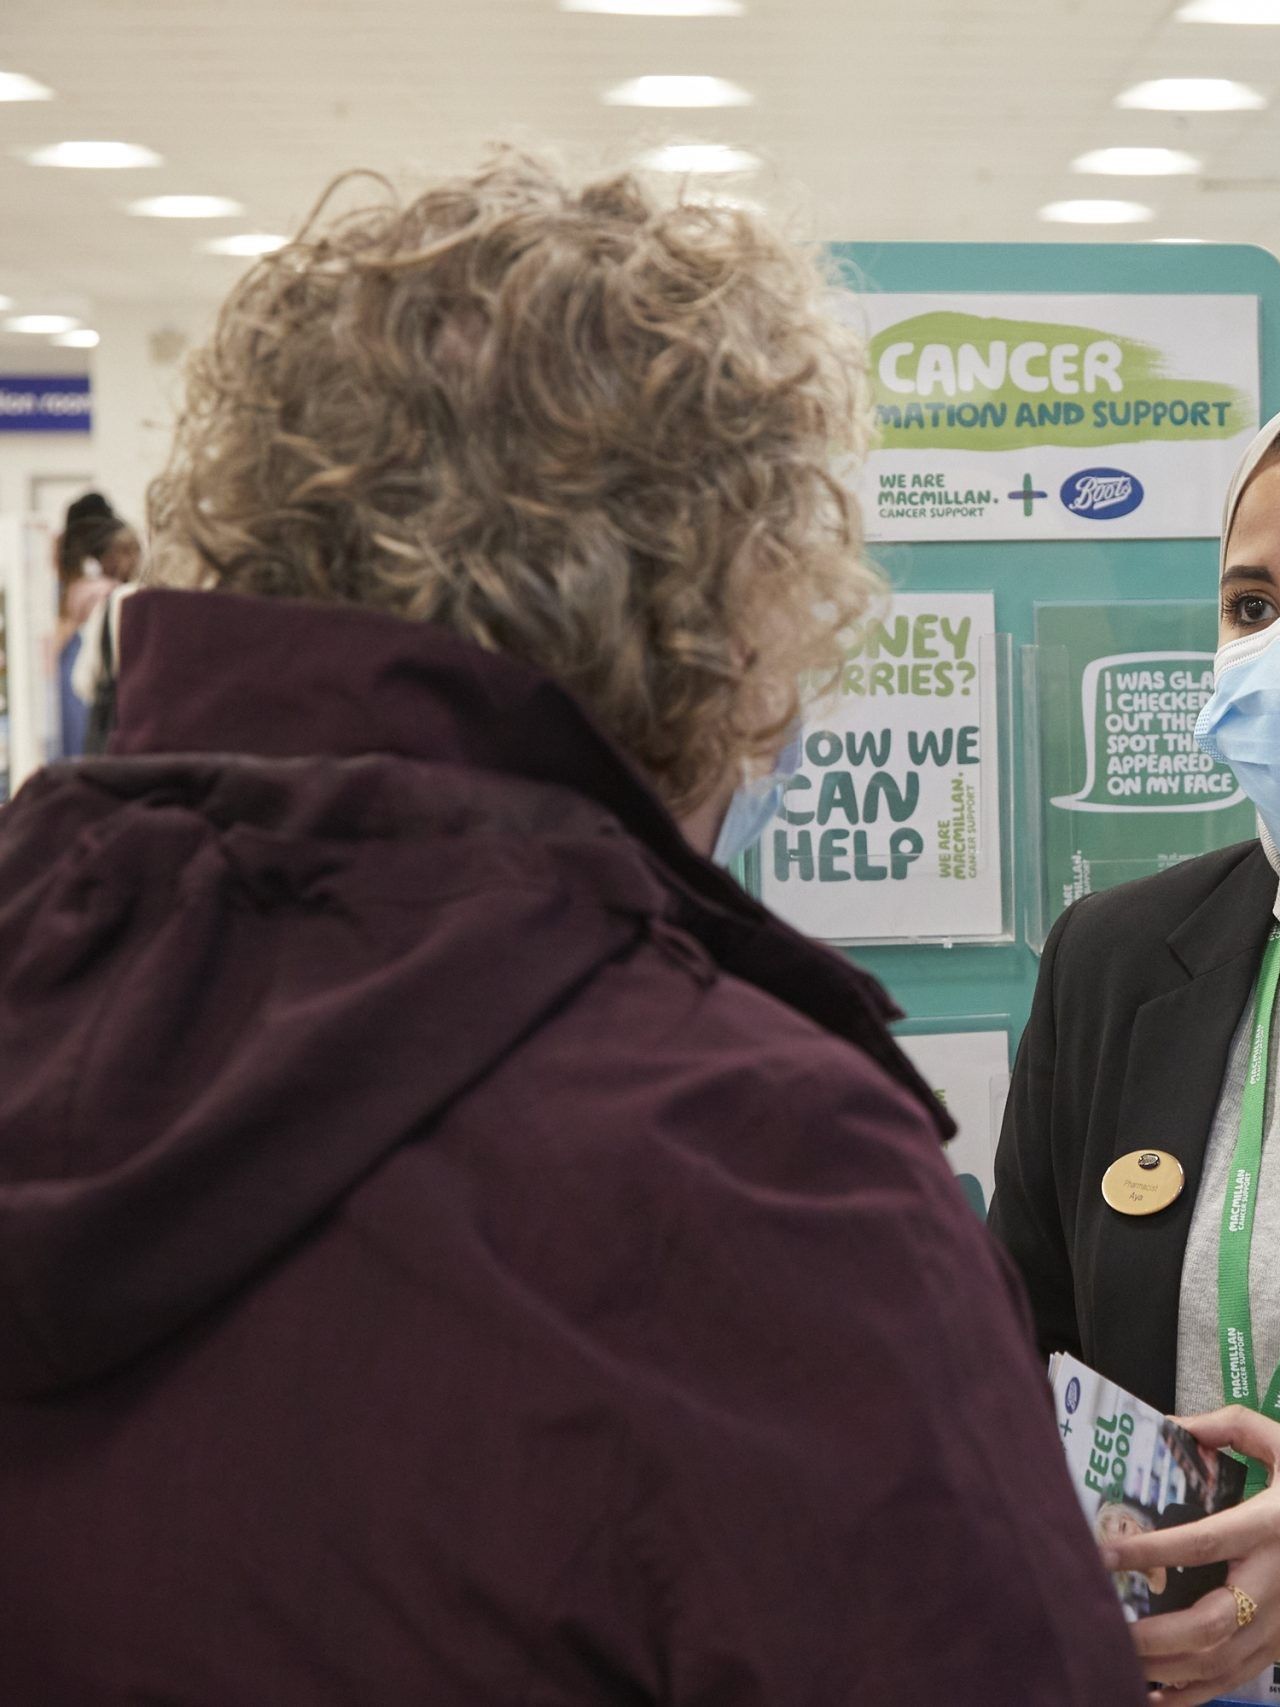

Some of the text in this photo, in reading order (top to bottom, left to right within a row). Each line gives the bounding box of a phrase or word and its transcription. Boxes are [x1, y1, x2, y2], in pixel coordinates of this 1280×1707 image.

[878, 340, 1124, 396] CANCER
[876, 400, 1232, 428] MATION AND SUPPORT
[878, 490, 998, 506] MACMILLAN.
[879, 473, 945, 488] WE ARE
[879, 506, 985, 519] CANCER SUPPORT
[847, 614, 972, 660] NEY
[842, 661, 976, 697] RRIES?
[1105, 671, 1215, 691] I WAS GLA
[1105, 692, 1112, 712] I
[1105, 712, 1197, 733] OUT THE
[805, 726, 980, 767] OW WE
[1107, 733, 1201, 754] SPOT TH
[1107, 754, 1214, 775] APPEARED
[1107, 773, 1233, 796] ON MY FACE
[777, 771, 920, 826] CAN
[951, 772, 966, 880] MACMILLAN.
[966, 785, 977, 879] CANCER SUPPORT
[773, 827, 924, 882] HELP
[937, 820, 951, 878] WE ARE
[1229, 1169, 1245, 1232] MACMILLAN
[1227, 1327, 1242, 1398] MACMILLAN
[1237, 1331, 1249, 1396] CANCER SUPPORT
[1084, 1414, 1117, 1493] FEEL
